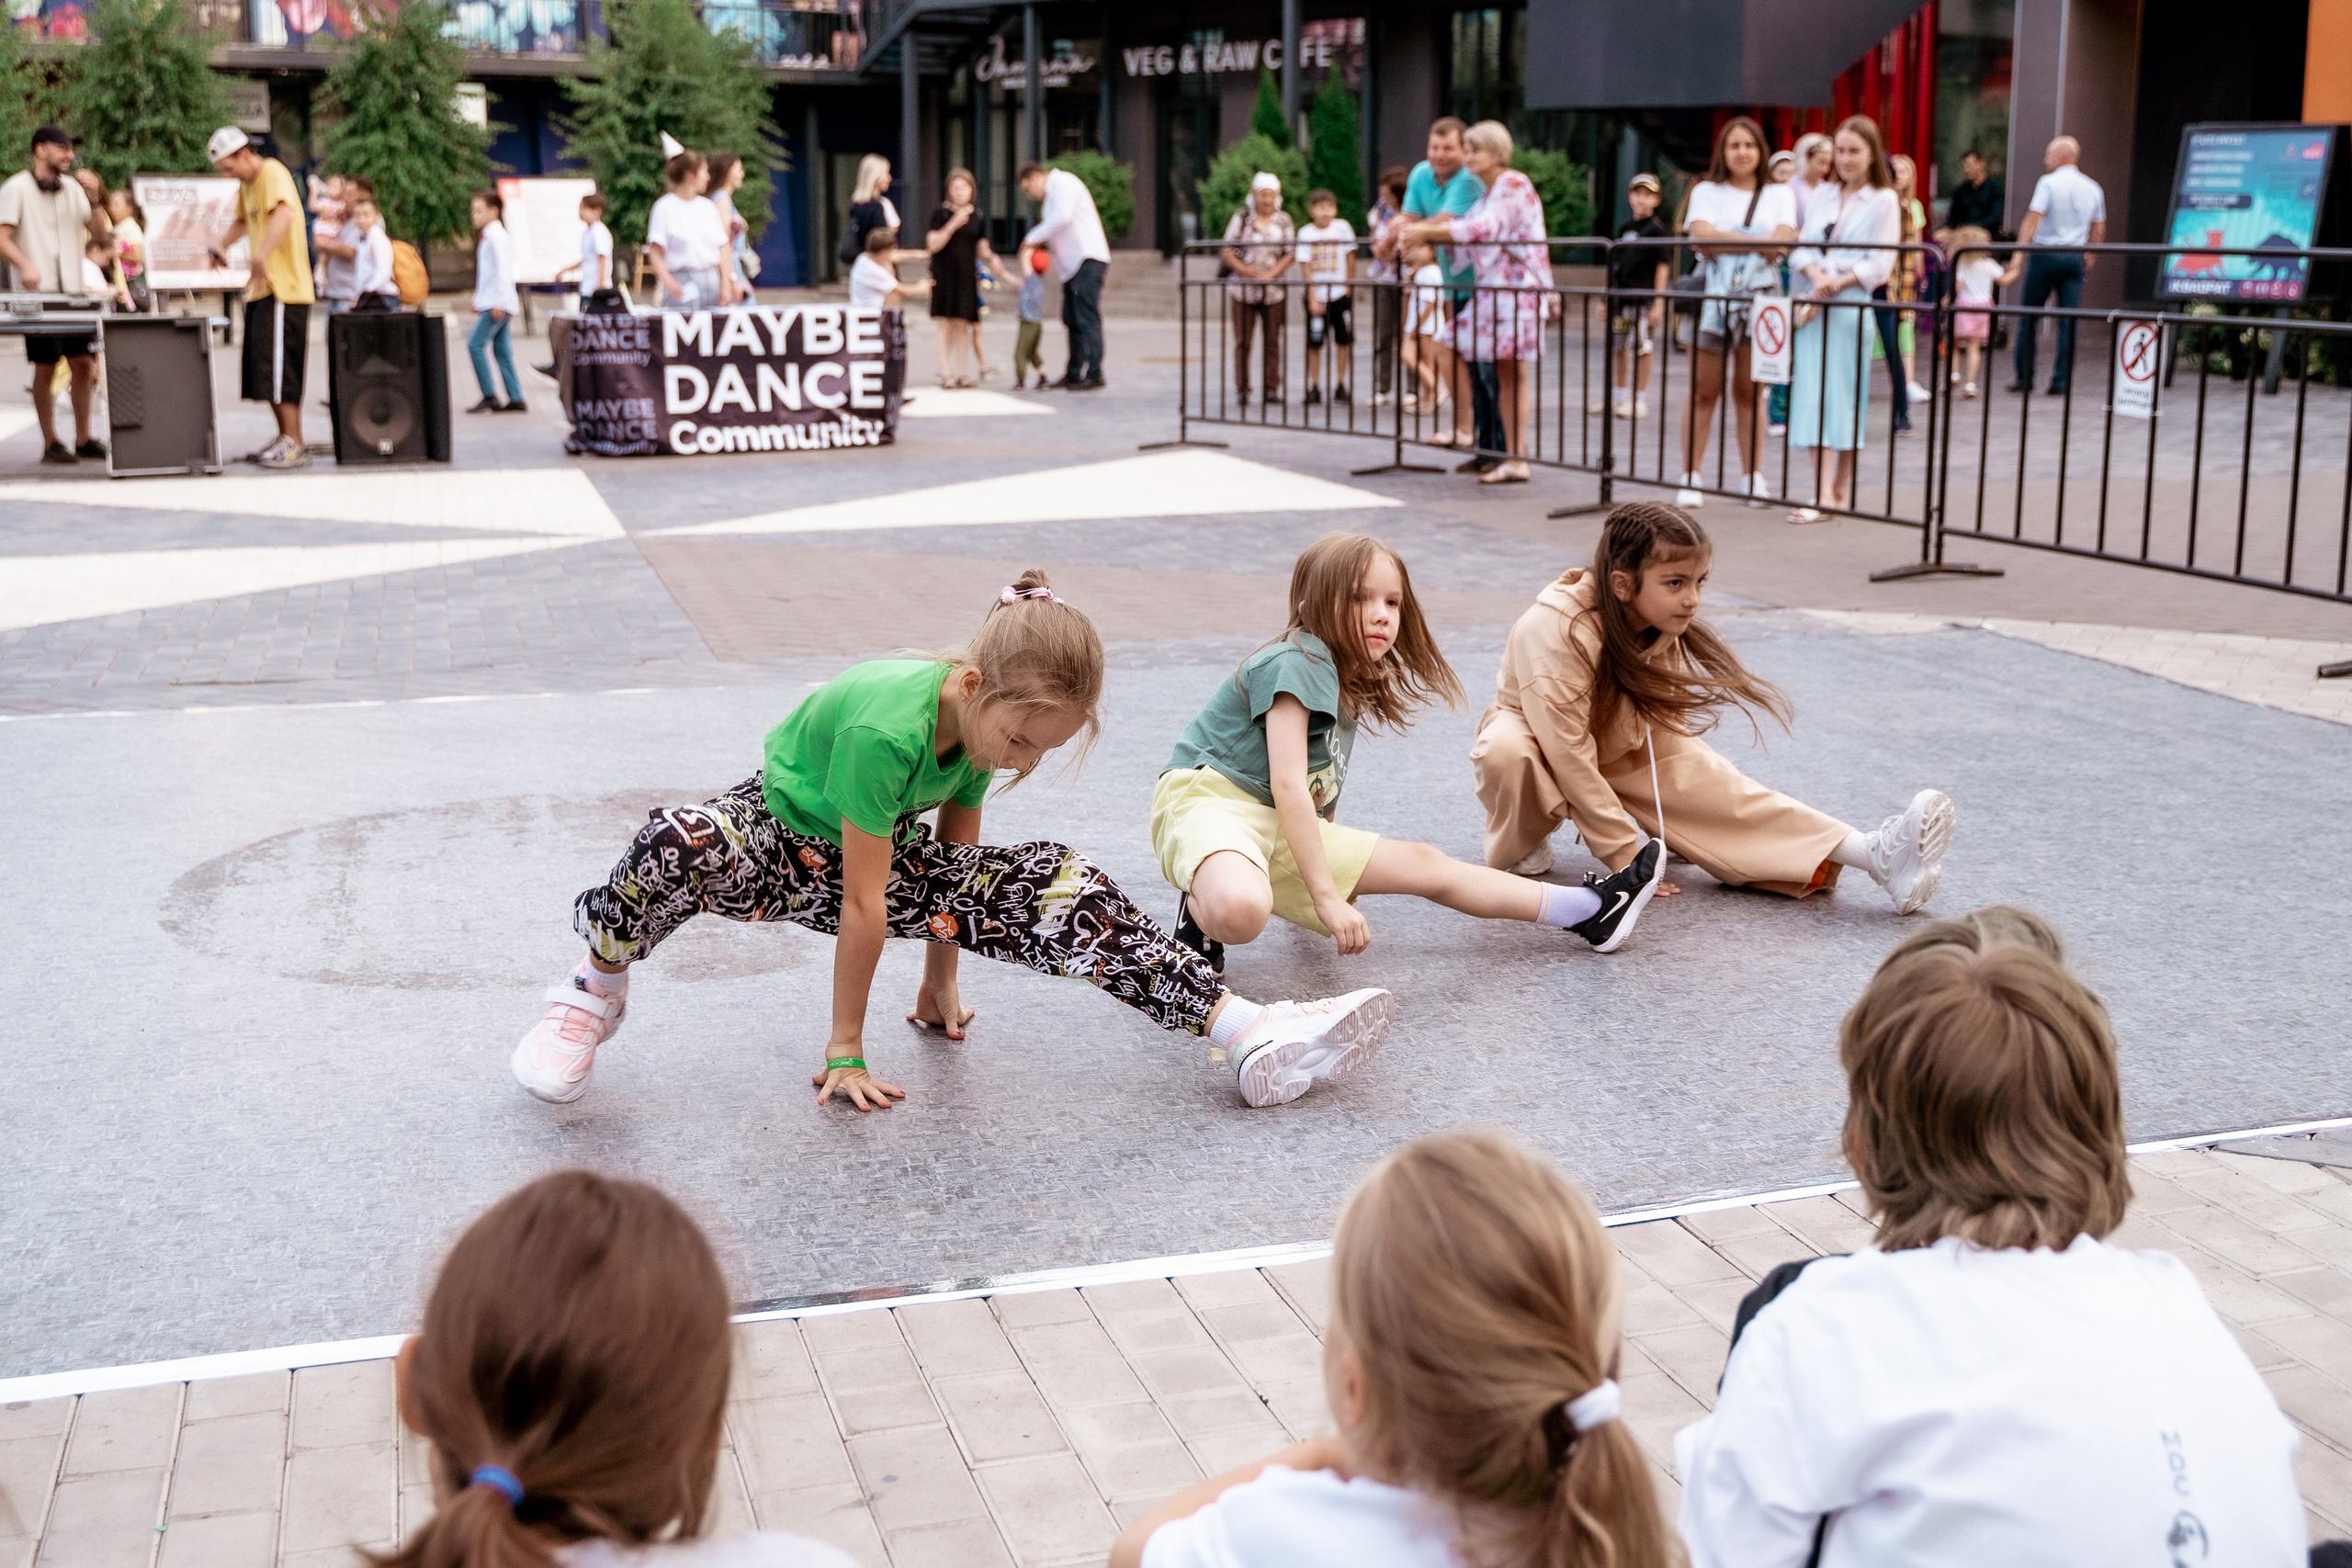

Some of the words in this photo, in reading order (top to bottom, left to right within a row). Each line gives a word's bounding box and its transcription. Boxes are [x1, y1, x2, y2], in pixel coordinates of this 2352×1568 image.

[1123, 46, 1175, 76] VEG
[1179, 43, 1196, 73] &
[1203, 39, 1260, 73] RAW
[1262, 38, 1332, 70] CFE
[571, 328, 651, 350] DANCE
[662, 309, 885, 357] MAYBE
[663, 360, 885, 414] DANCE
[574, 398, 655, 422] MAYBE
[668, 415, 885, 456] Community
